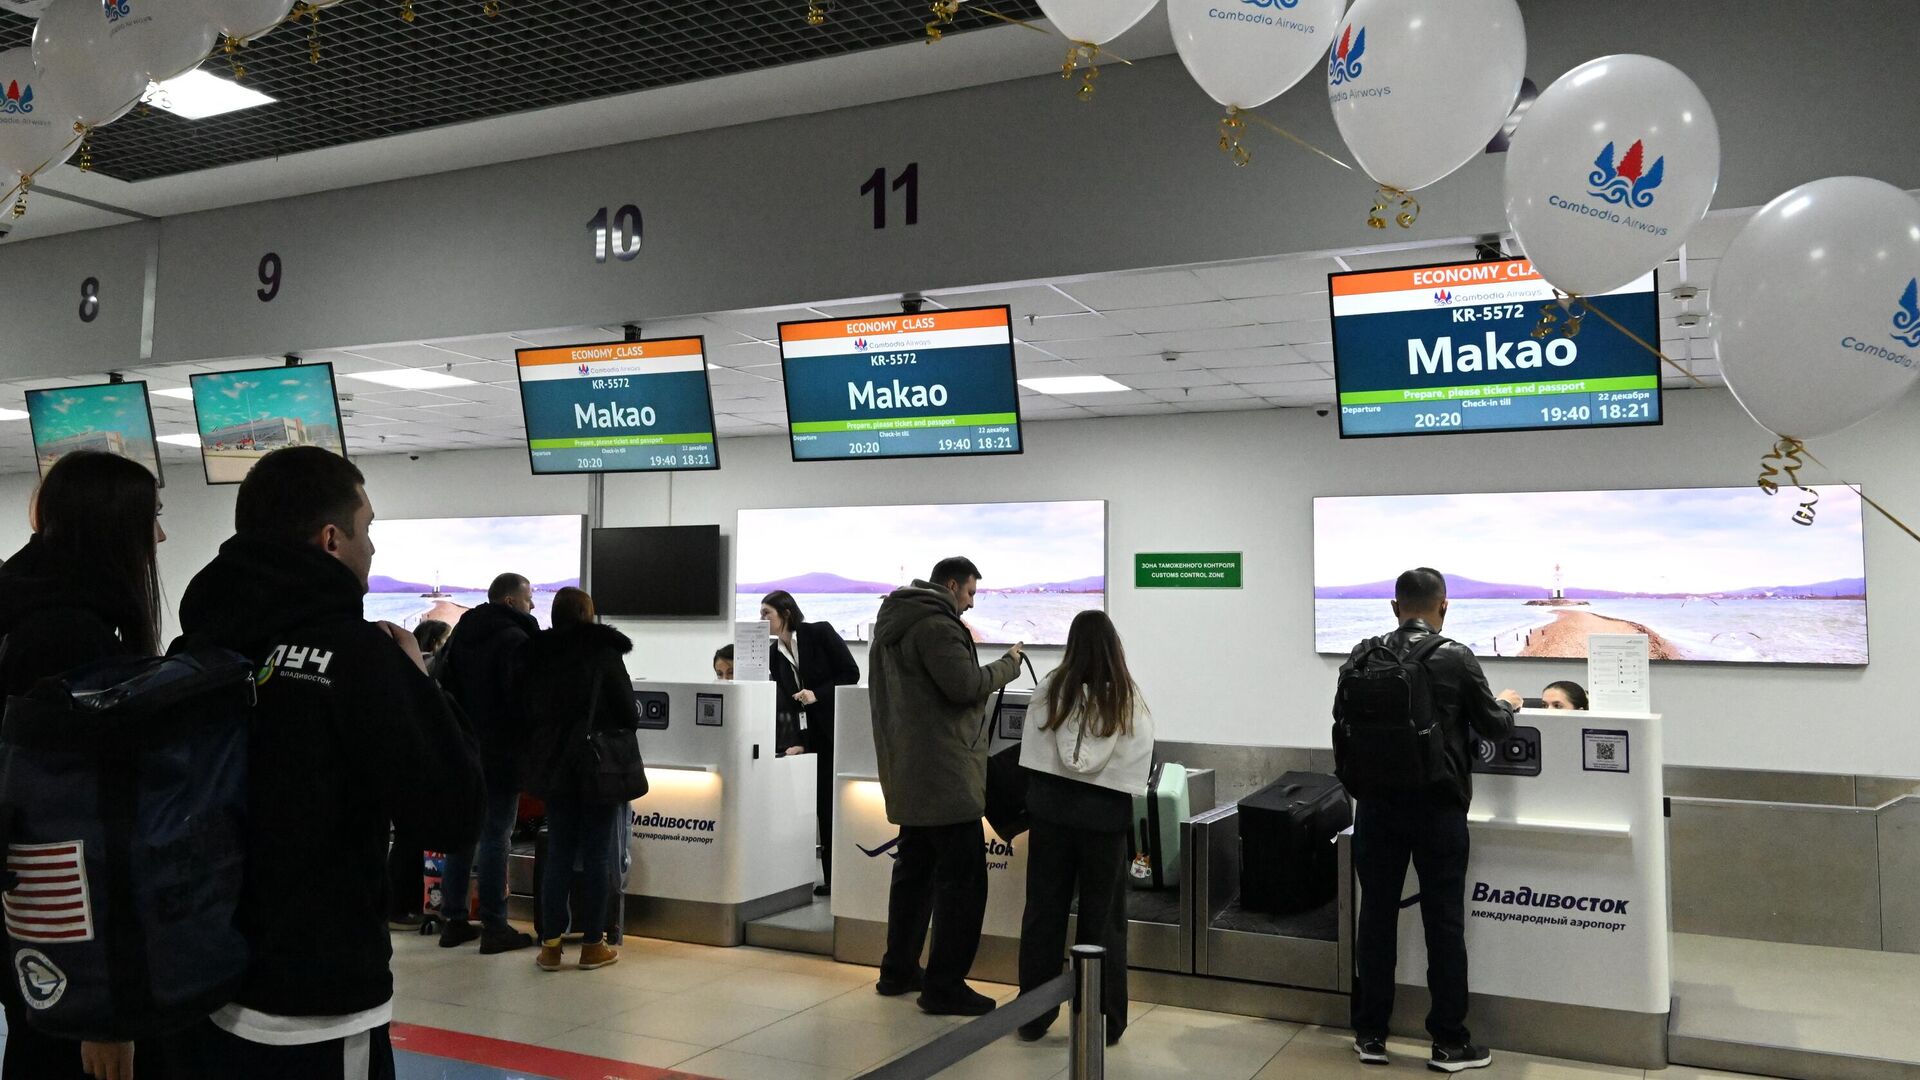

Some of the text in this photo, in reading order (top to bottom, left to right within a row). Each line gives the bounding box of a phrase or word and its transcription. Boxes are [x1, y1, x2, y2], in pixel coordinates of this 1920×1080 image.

[1208, 8, 1315, 34] Cambodia Airways
[1349, 86, 1392, 99] Airways
[859, 162, 918, 229] 11
[1548, 195, 1669, 236] Cambodia Airways
[586, 204, 643, 264] 10
[257, 252, 282, 302] 9
[1413, 263, 1540, 285] ECONOMY_CLA
[79, 276, 99, 322] 8
[1454, 289, 1543, 303] Cambodia Airways
[1452, 304, 1525, 323] KR-5572
[846, 317, 935, 334] ECONOMY_CLASS
[571, 346, 643, 360] ECONOMY_CLASS
[870, 353, 917, 367] KR-5572
[1407, 331, 1578, 375] Makao
[1841, 336, 1913, 368] Cambodia
[592, 378, 630, 389] KR-5572
[1403, 382, 1585, 399] Prepare, please ticket and passport
[847, 379, 948, 410] Makao
[1598, 392, 1650, 402] 22 декабря
[1342, 405, 1382, 415] Departure
[1462, 398, 1511, 408] Check-in till
[1599, 402, 1650, 419] 18:21
[574, 401, 657, 429] Makao
[914, 418, 926, 426] and
[1414, 412, 1462, 428] 20:20
[1540, 406, 1590, 422] 19:40
[849, 441, 880, 454] 20:20
[938, 438, 971, 451] 19:40
[978, 436, 1012, 449] 18:21
[577, 457, 603, 469] 20:20
[650, 455, 677, 466] 19:40
[682, 454, 711, 465] 18:21
[280, 670, 332, 687] ВЛАДИВОСТОК
[632, 831, 714, 845] ждународный аэропорт
[1471, 882, 1630, 915] Владивосток
[1471, 909, 1627, 932] международный аэропорт
